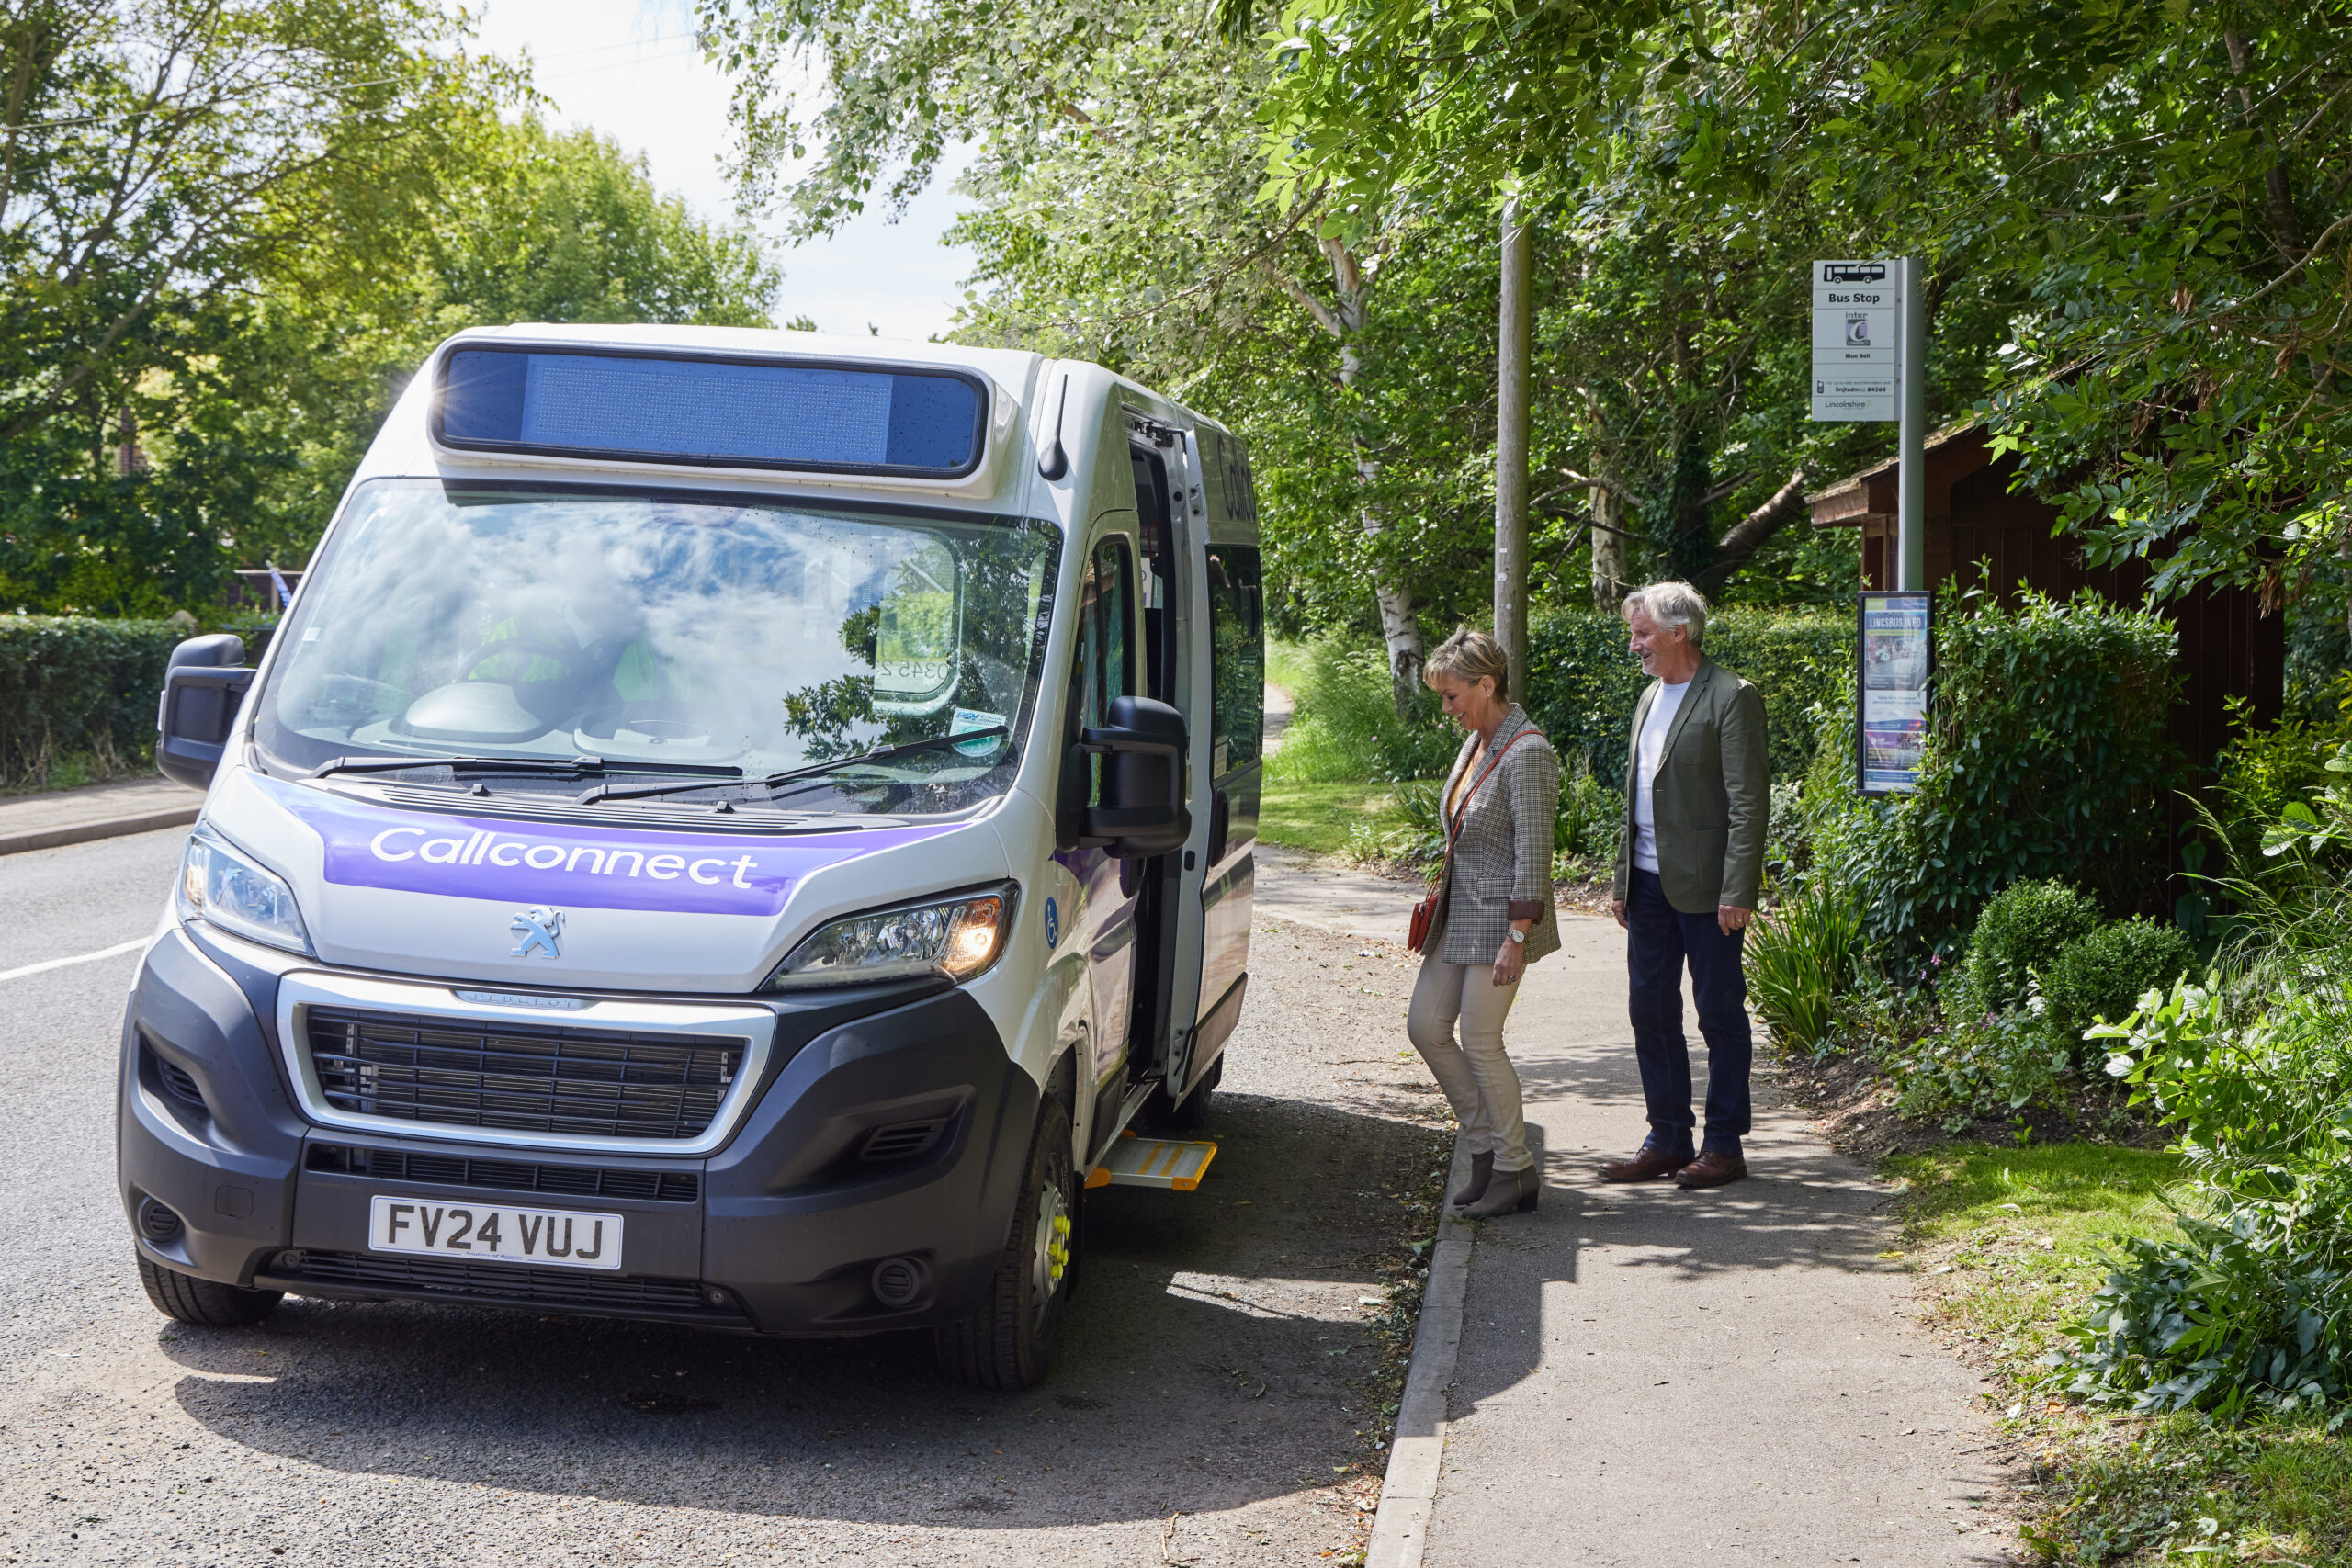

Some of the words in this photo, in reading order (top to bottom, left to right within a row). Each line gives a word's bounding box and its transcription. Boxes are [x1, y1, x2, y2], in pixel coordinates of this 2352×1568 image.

[1828, 293, 1849, 302] Bus
[1853, 293, 1880, 304] Stop
[369, 827, 758, 889] Callconnect
[474, 993, 574, 1008] PEUGEOT
[388, 1203, 502, 1252] FV24
[518, 1213, 603, 1260] VUJ
